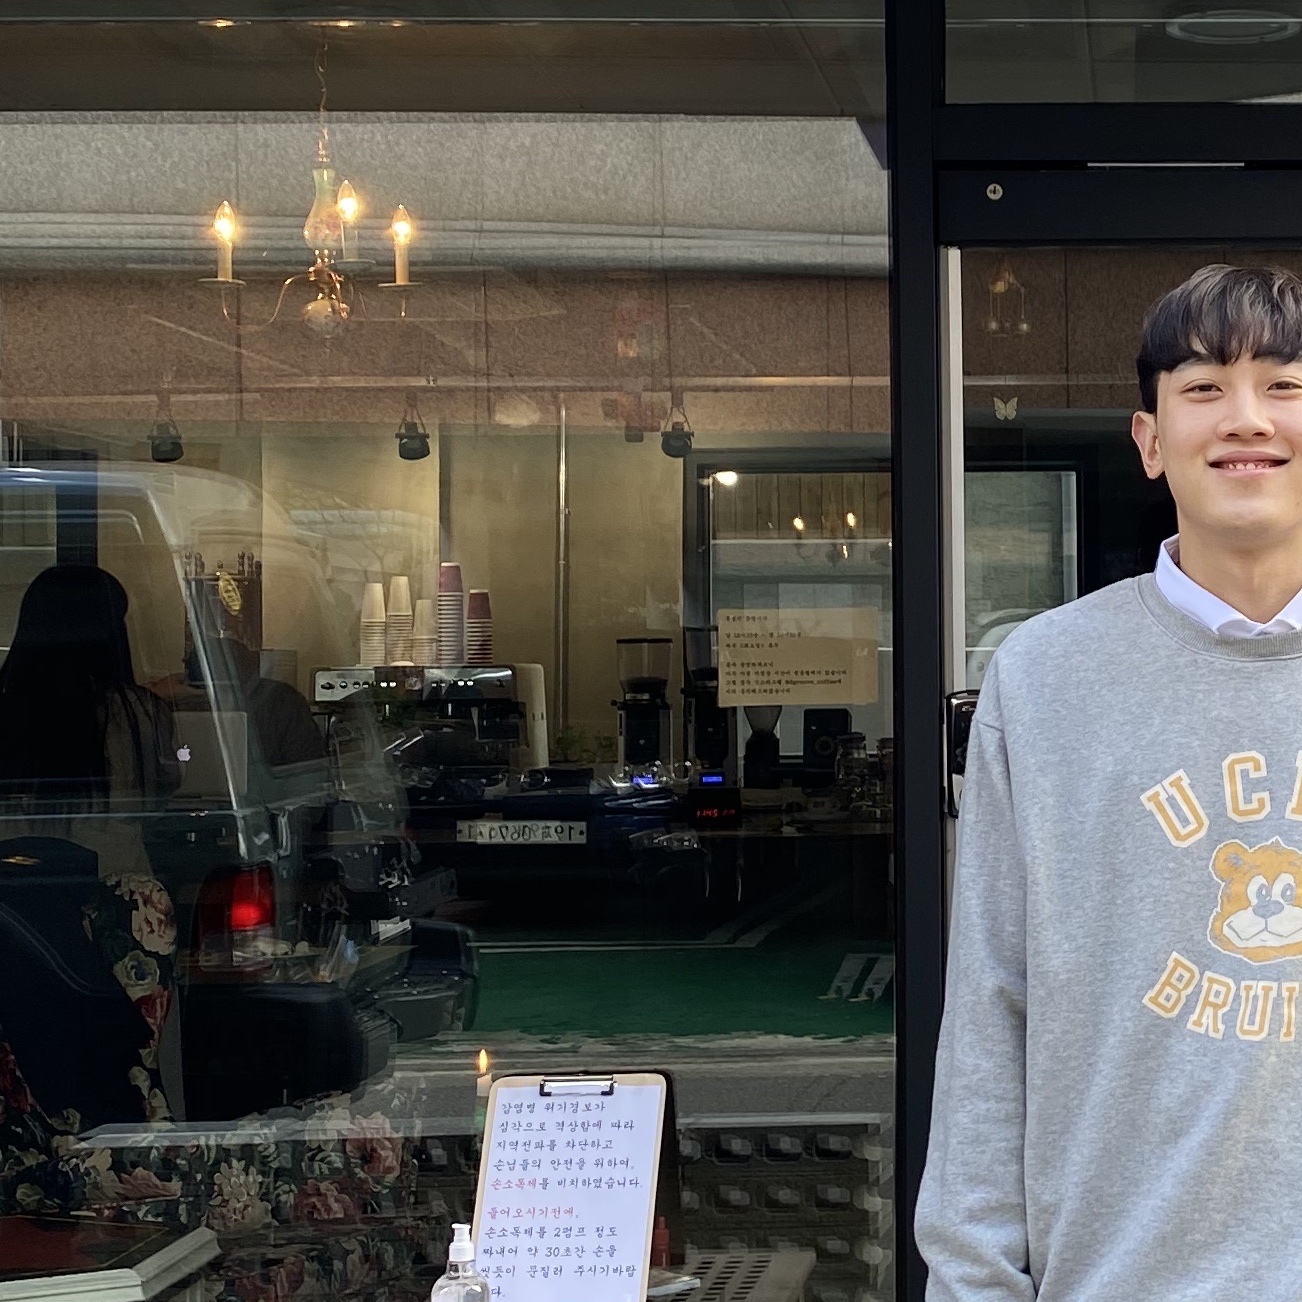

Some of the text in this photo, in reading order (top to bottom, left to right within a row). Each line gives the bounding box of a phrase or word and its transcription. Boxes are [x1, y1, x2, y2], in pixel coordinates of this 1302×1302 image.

[501, 1101, 606, 1114] 감염병 위기경보가
[499, 1119, 635, 1133] 심각으로 격상함에 따라
[496, 1139, 613, 1152] 지역전파를 차단하고
[493, 1158, 542, 1172] 손님들의
[549, 1158, 586, 1171] 안전을
[491, 1178, 550, 1190] 손소독제를
[484, 1226, 618, 1239] 손소독제를 2펌프 정도
[482, 1244, 617, 1258] 짜내어 약 30초간 손을
[526, 1265, 563, 1278] 문질러
[573, 1264, 637, 1278] 주시기바람
